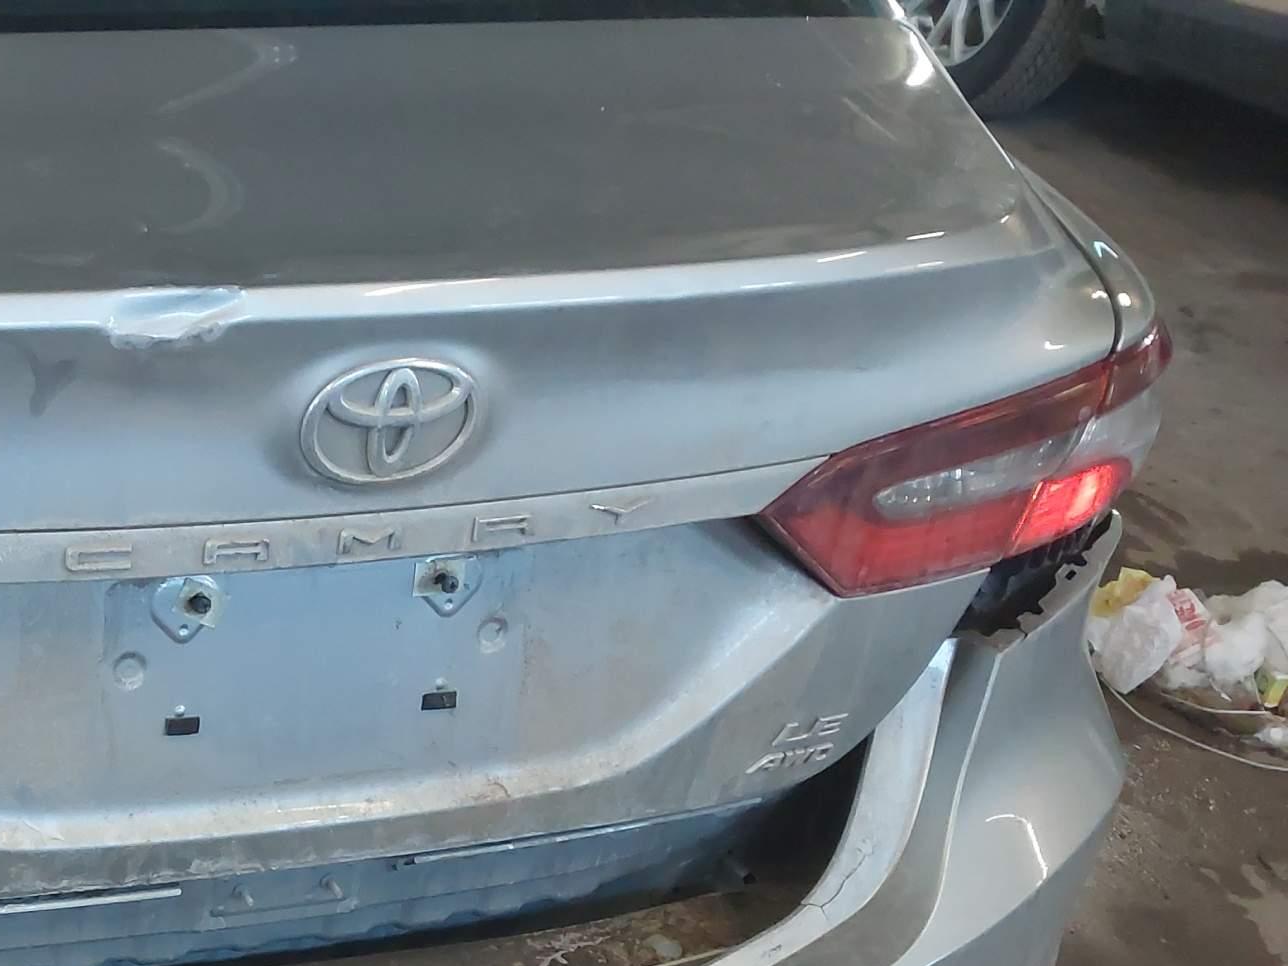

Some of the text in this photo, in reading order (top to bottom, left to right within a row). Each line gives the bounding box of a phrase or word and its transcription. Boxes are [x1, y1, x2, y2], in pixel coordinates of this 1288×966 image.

[65, 496, 656, 572] CAMRY
[771, 713, 849, 746] LE
[745, 743, 834, 774] AWD
